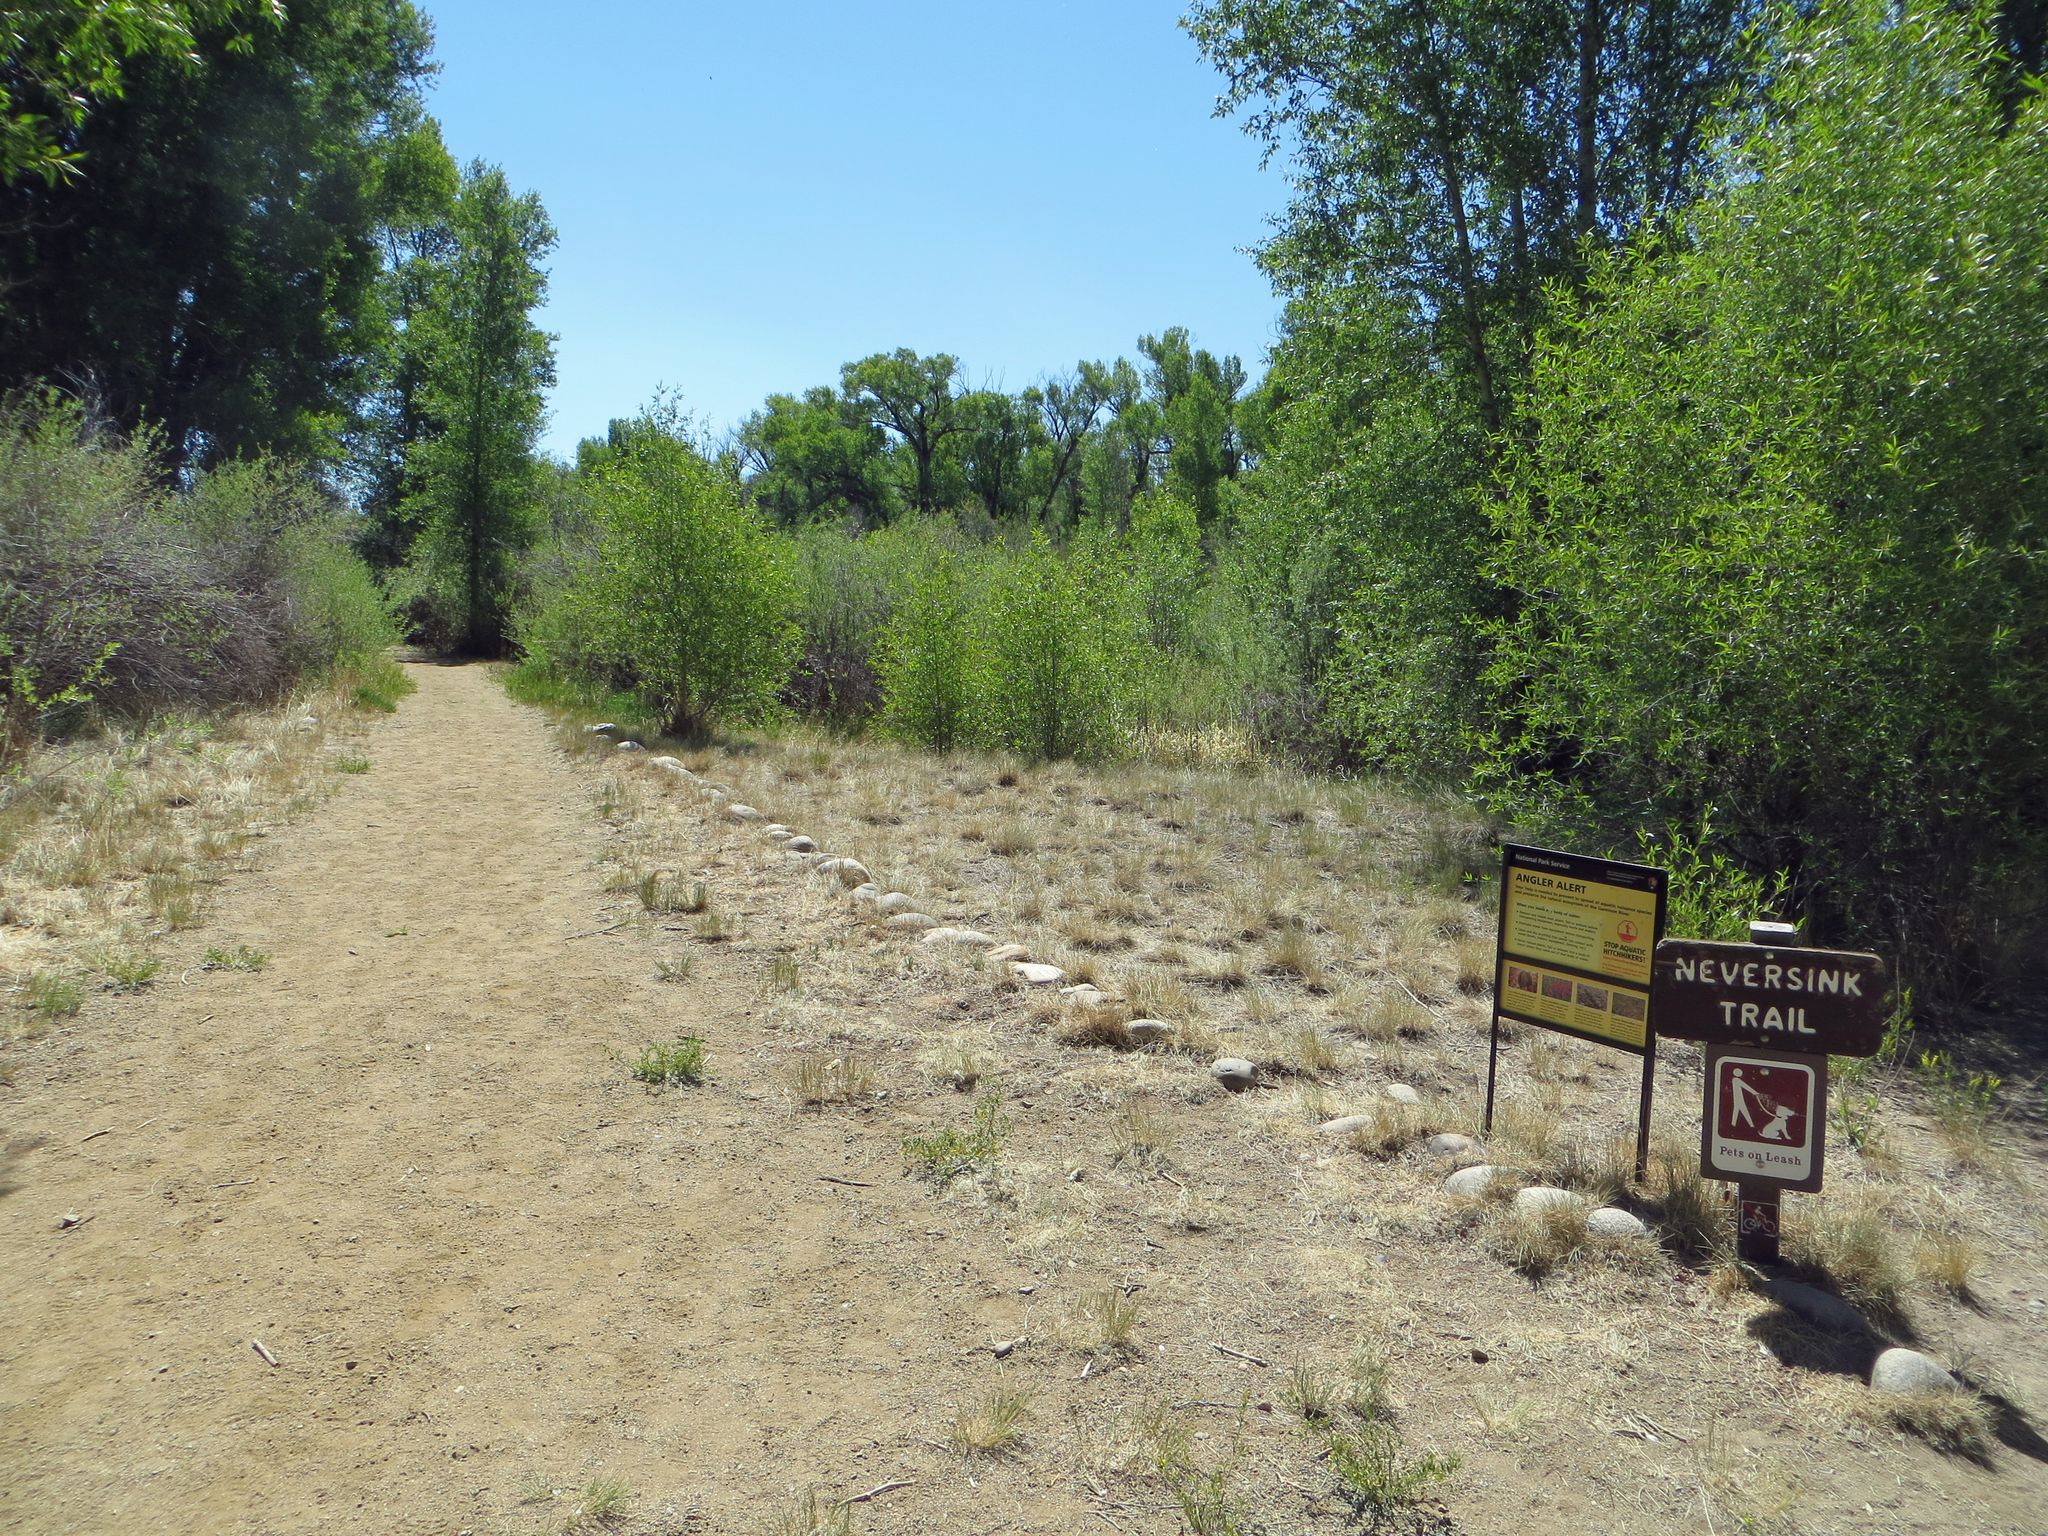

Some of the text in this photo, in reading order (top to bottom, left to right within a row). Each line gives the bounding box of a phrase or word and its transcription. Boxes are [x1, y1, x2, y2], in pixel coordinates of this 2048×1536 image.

[1515, 854, 1570, 869] National Park Service
[1516, 873, 1587, 894] ANGLER ALERT
[1603, 941, 1619, 950] STOP
[1619, 944, 1646, 956] AQUATIC
[1674, 957, 1863, 997] NEVERSINK
[1719, 1001, 1817, 1034] TRAIL
[1719, 1146, 1802, 1166] Pets on Leash
